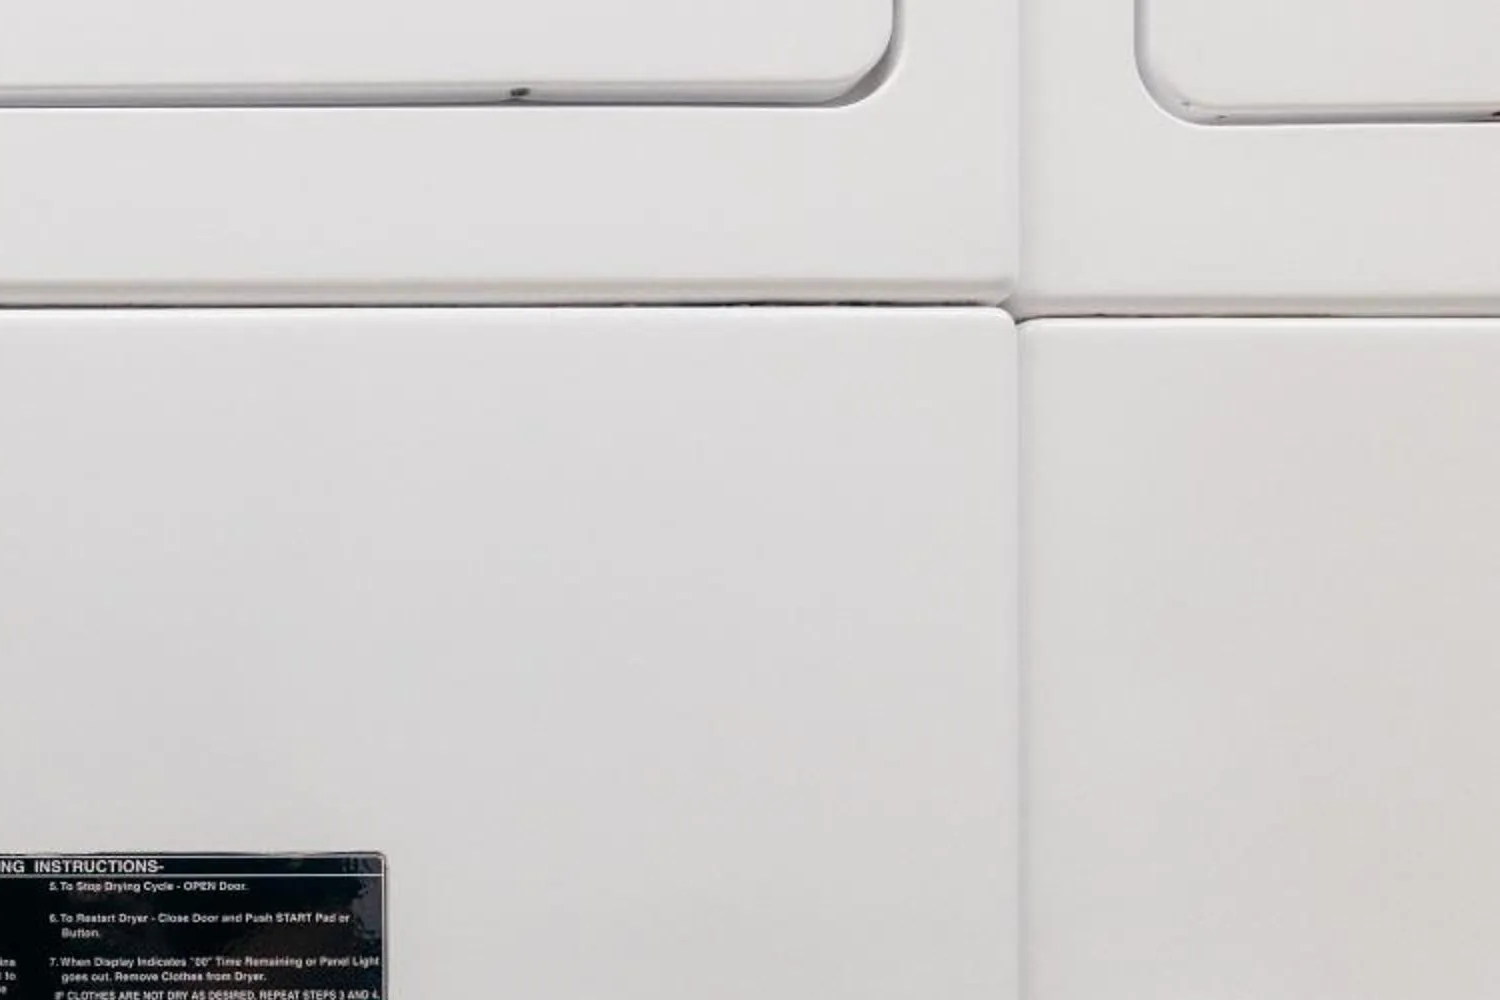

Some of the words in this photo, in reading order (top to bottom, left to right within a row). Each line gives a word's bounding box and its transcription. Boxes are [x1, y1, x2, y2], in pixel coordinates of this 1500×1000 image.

[34, 860, 164, 873] INSTRUCTIONS-
[49, 882, 58, 891] 5.
[60, 882, 74, 891] To
[76, 882, 101, 893] Stop
[104, 882, 140, 893] Drying
[143, 882, 174, 893] Cycle
[183, 882, 215, 891] OPEN
[218, 882, 249, 891] Door.
[49, 914, 58, 923] 6.
[60, 914, 74, 923] To
[76, 914, 116, 923] Restart
[119, 914, 148, 924] Dryer
[158, 914, 189, 923] Close
[192, 914, 218, 923] Door
[222, 914, 242, 923] and
[245, 914, 273, 923] Push
[276, 914, 312, 923] START
[315, 914, 337, 923] Pad
[339, 914, 350, 923] or
[61, 928, 100, 938] Button.
[50, 957, 59, 967] 7.
[61, 957, 92, 967] When
[94, 957, 134, 968] Display
[137, 957, 186, 967] Indicates
[190, 957, 213, 967] "00"
[216, 957, 242, 967] Time
[245, 957, 303, 968] Remaining
[306, 957, 317, 967] or
[320, 957, 350, 967] Panel
[352, 957, 380, 968] Light
[5, 971, 16, 980] to
[61, 974, 89, 982] goes
[115, 972, 158, 981] Remove
[162, 972, 203, 981] Clothes
[206, 972, 232, 981] from
[235, 972, 266, 982] Dryer.
[55, 991, 65, 1000] IF
[67, 991, 116, 1000] CLOTHES
[118, 991, 140, 1000] ARE
[143, 991, 164, 1000] NOT
[167, 991, 189, 1000] DRY
[191, 991, 205, 1000] AS
[260, 991, 300, 1000] REPEAT
[303, 991, 336, 1000] STEPS
[339, 991, 345, 1000] 3
[347, 991, 368, 1000] AND
[371, 991, 380, 1000] 4.
